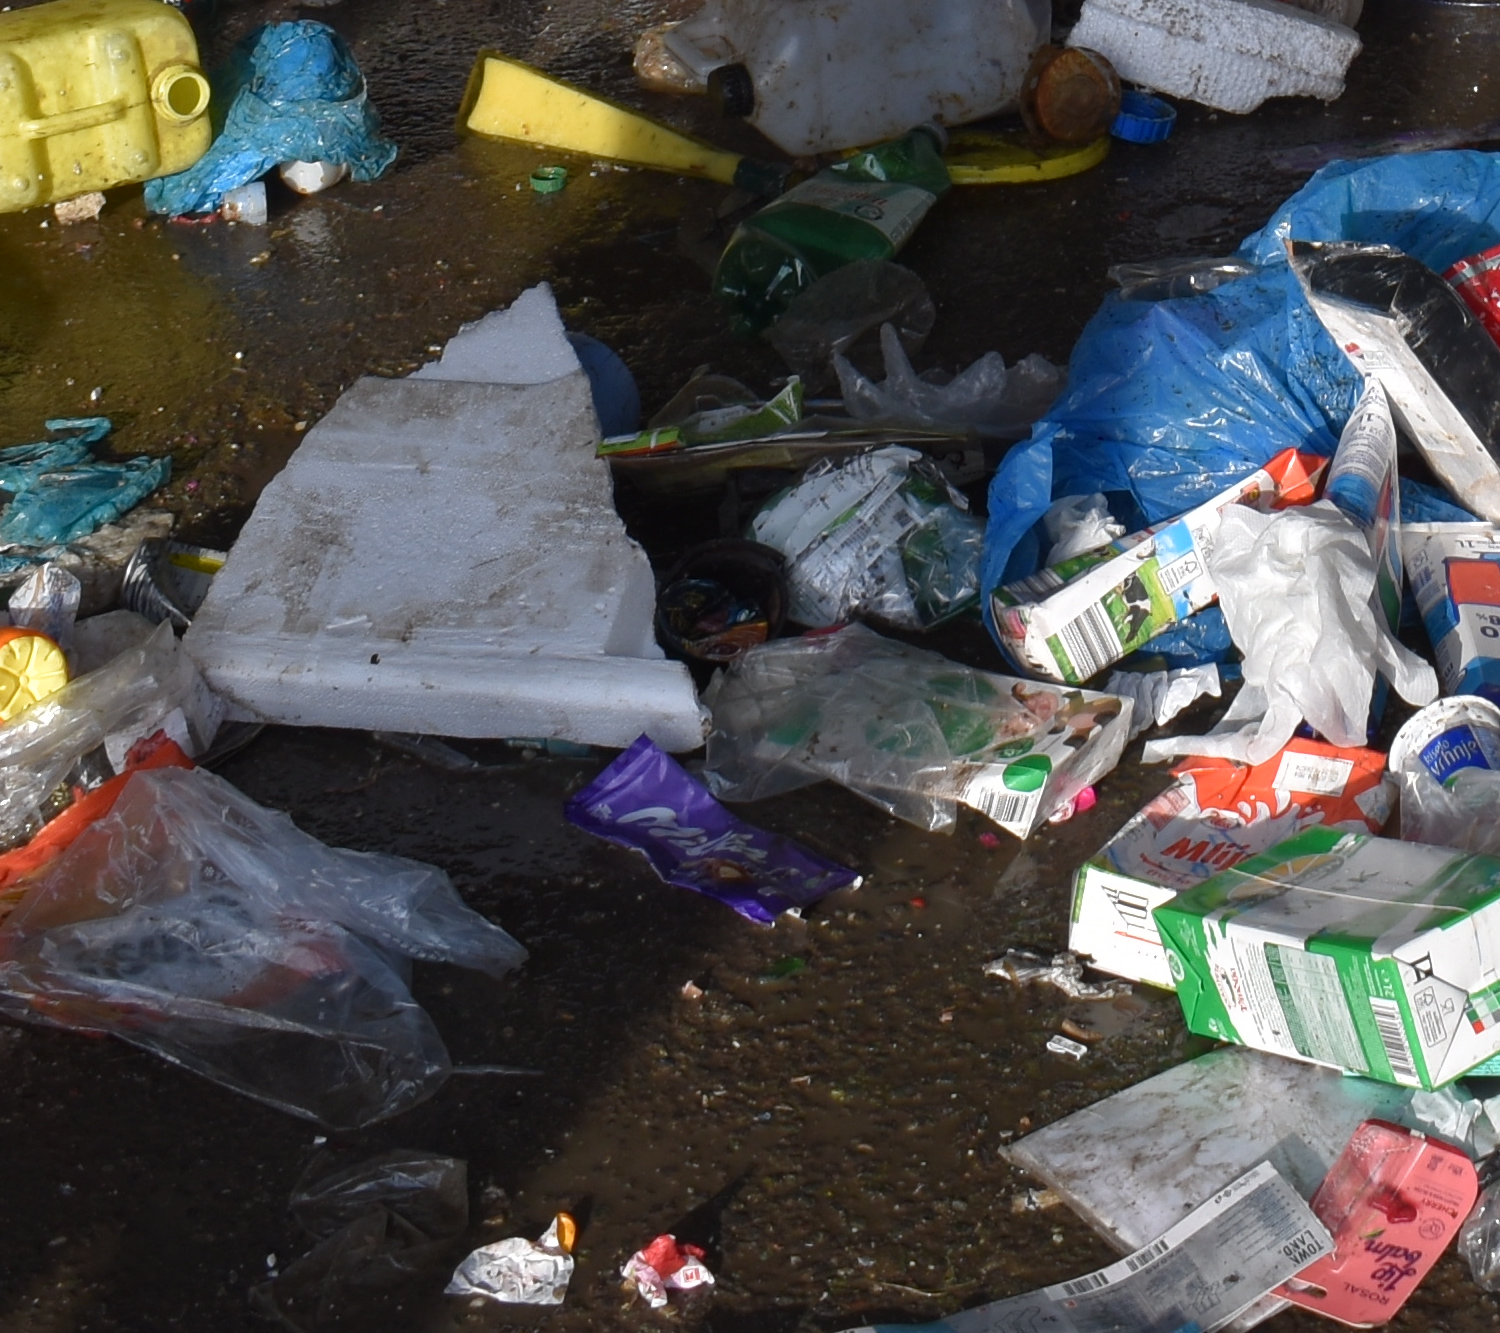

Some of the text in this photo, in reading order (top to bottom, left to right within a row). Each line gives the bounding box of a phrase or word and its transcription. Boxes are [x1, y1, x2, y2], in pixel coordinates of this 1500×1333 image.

[1422, 738, 1451, 766] kiselo
[1429, 738, 1479, 778] vrhnje
[1364, 1239, 1423, 1265] balm
[1370, 1262, 1417, 1292] Lip
[1343, 1280, 1391, 1306] ROSAL
